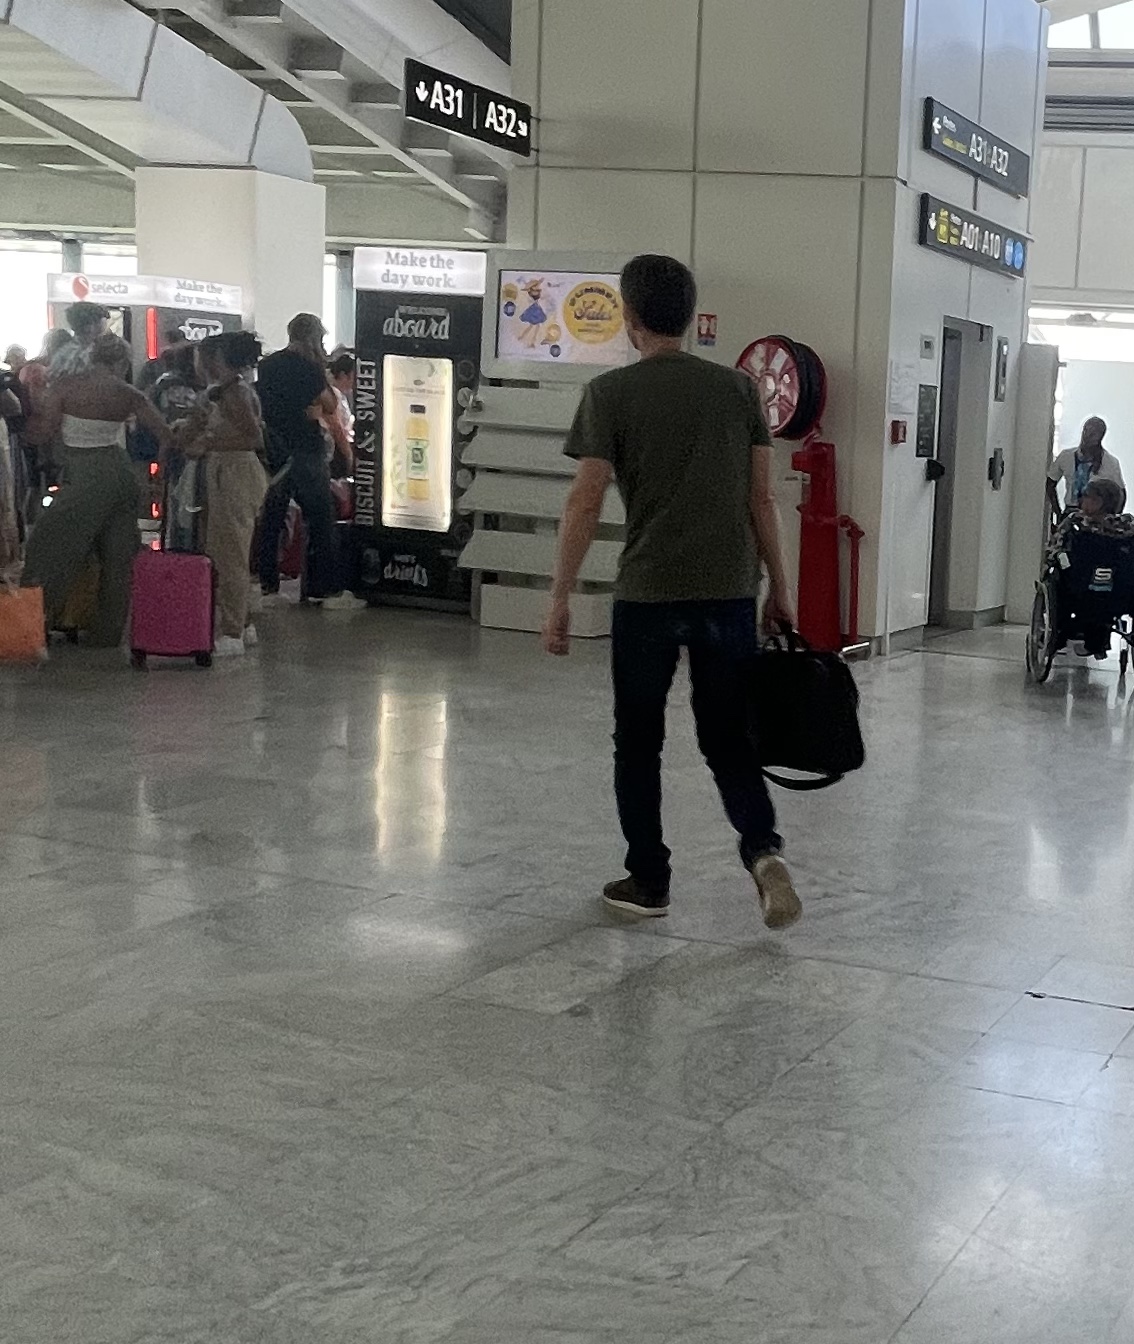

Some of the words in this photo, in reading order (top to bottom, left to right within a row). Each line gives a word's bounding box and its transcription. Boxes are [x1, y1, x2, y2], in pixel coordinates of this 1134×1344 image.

[430, 80, 463, 119] A31
[484, 100, 517, 138] A32
[968, 133, 988, 165] A31
[990, 145, 1009, 177] A32
[380, 269, 409, 289] day
[411, 273, 457, 289] work.
[384, 251, 427, 268] Make
[429, 254, 455, 270] the
[91, 282, 129, 295] selecta
[355, 357, 377, 422] SWEET
